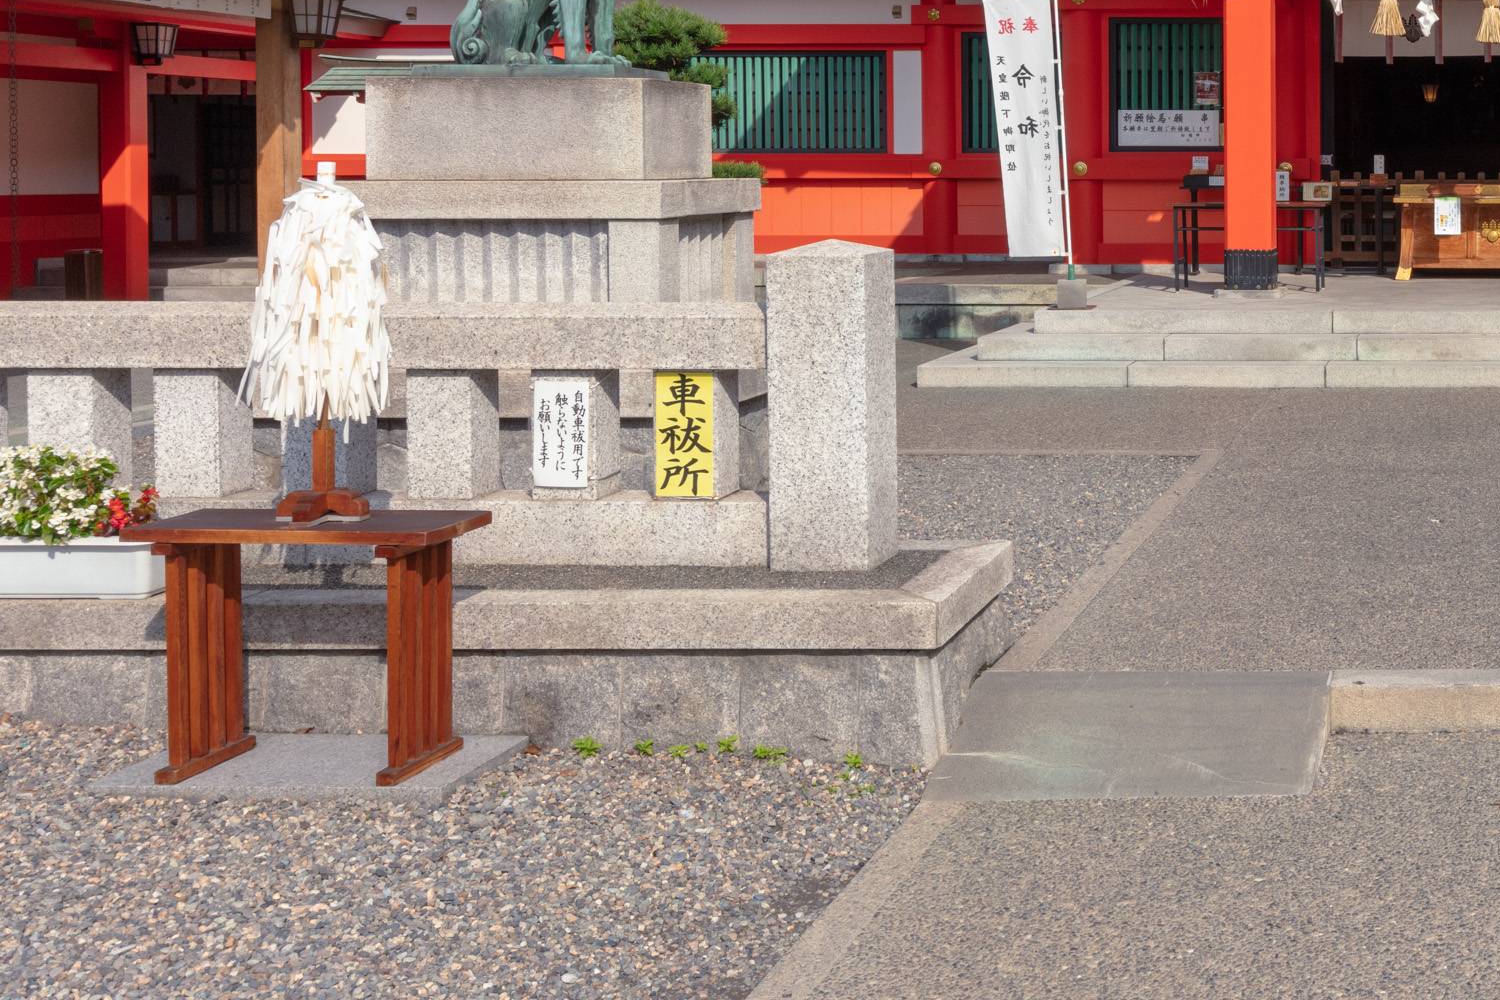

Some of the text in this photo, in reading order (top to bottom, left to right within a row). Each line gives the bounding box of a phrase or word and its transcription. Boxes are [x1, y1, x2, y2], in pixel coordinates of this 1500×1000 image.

[538, 398, 551, 468] お願いします
[555, 393, 568, 471] 触らないように
[571, 390, 586, 480] 自動車祓用です
[659, 373, 712, 496] 車祓所
